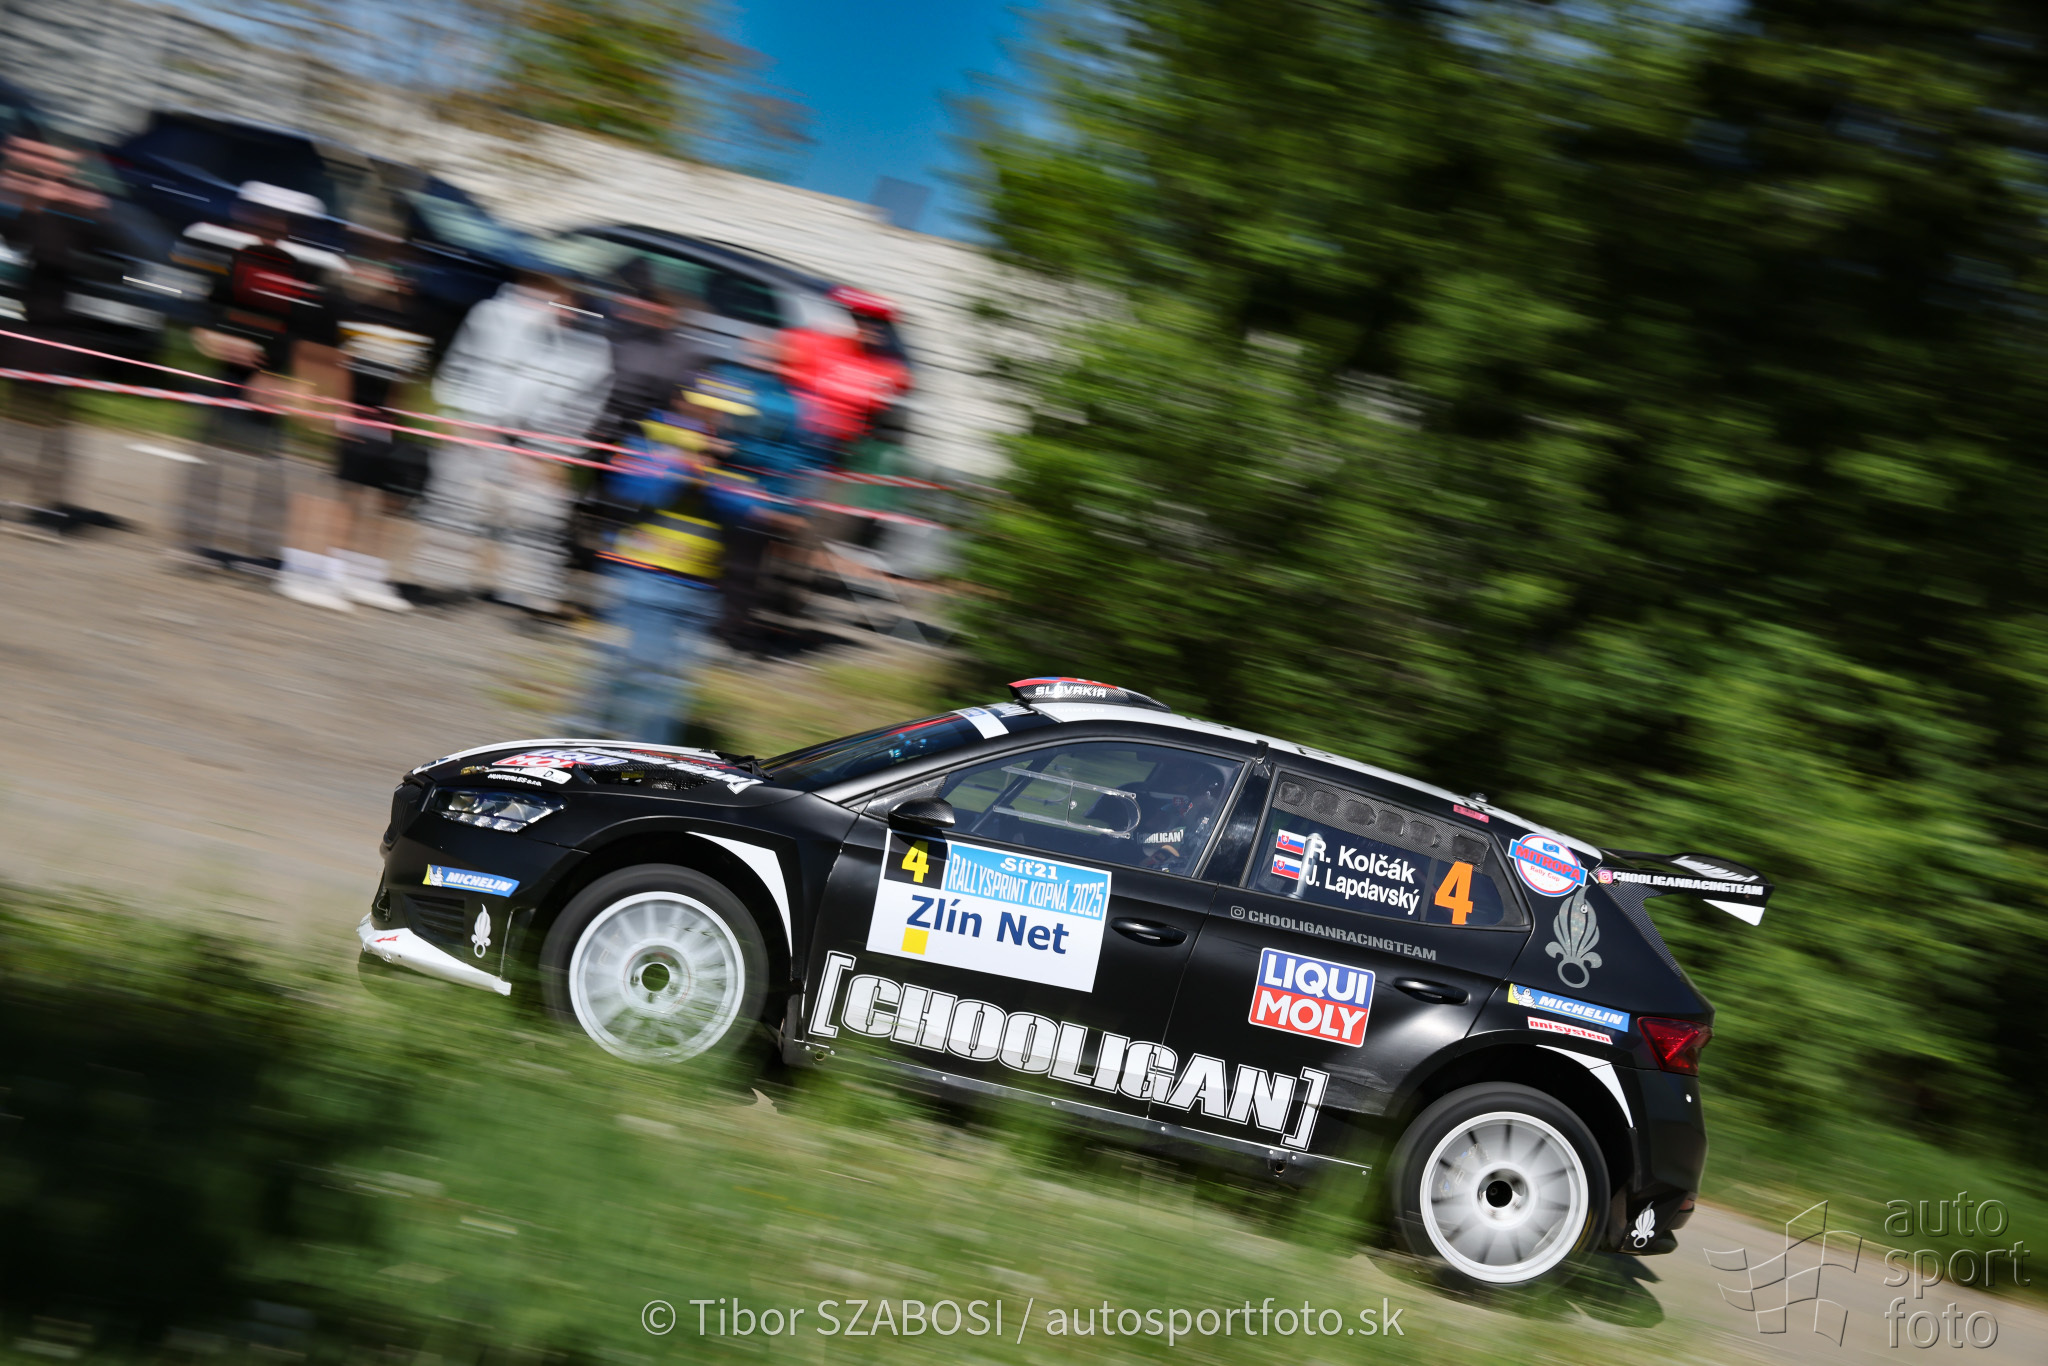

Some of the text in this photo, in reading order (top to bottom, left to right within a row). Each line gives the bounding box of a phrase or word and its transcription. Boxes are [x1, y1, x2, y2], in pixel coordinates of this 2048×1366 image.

[1035, 685, 1107, 698] SLOVAKIA
[500, 755, 573, 768] MOL
[445, 872, 513, 892] MICHELIN
[901, 839, 930, 884] 4
[1309, 838, 1416, 884] R. Kolčák
[1515, 845, 1581, 881] MITROPA
[1530, 865, 1561, 883] Rally Cup
[1613, 871, 1764, 896] CHOOLIGANRACINGTEAM
[949, 853, 1105, 918] RALLYSPRINT KOPNÁ 2025
[1305, 865, 1421, 916] J. Lapdavský
[1434, 860, 1474, 926] 4
[906, 894, 1070, 955] Zlín Net
[1248, 910, 1437, 961] CHOOLIGANRACINGTEAM
[1264, 953, 1368, 1005] LIQUI
[1256, 989, 1366, 1040] MOLY
[1538, 995, 1624, 1025] MICHELIN
